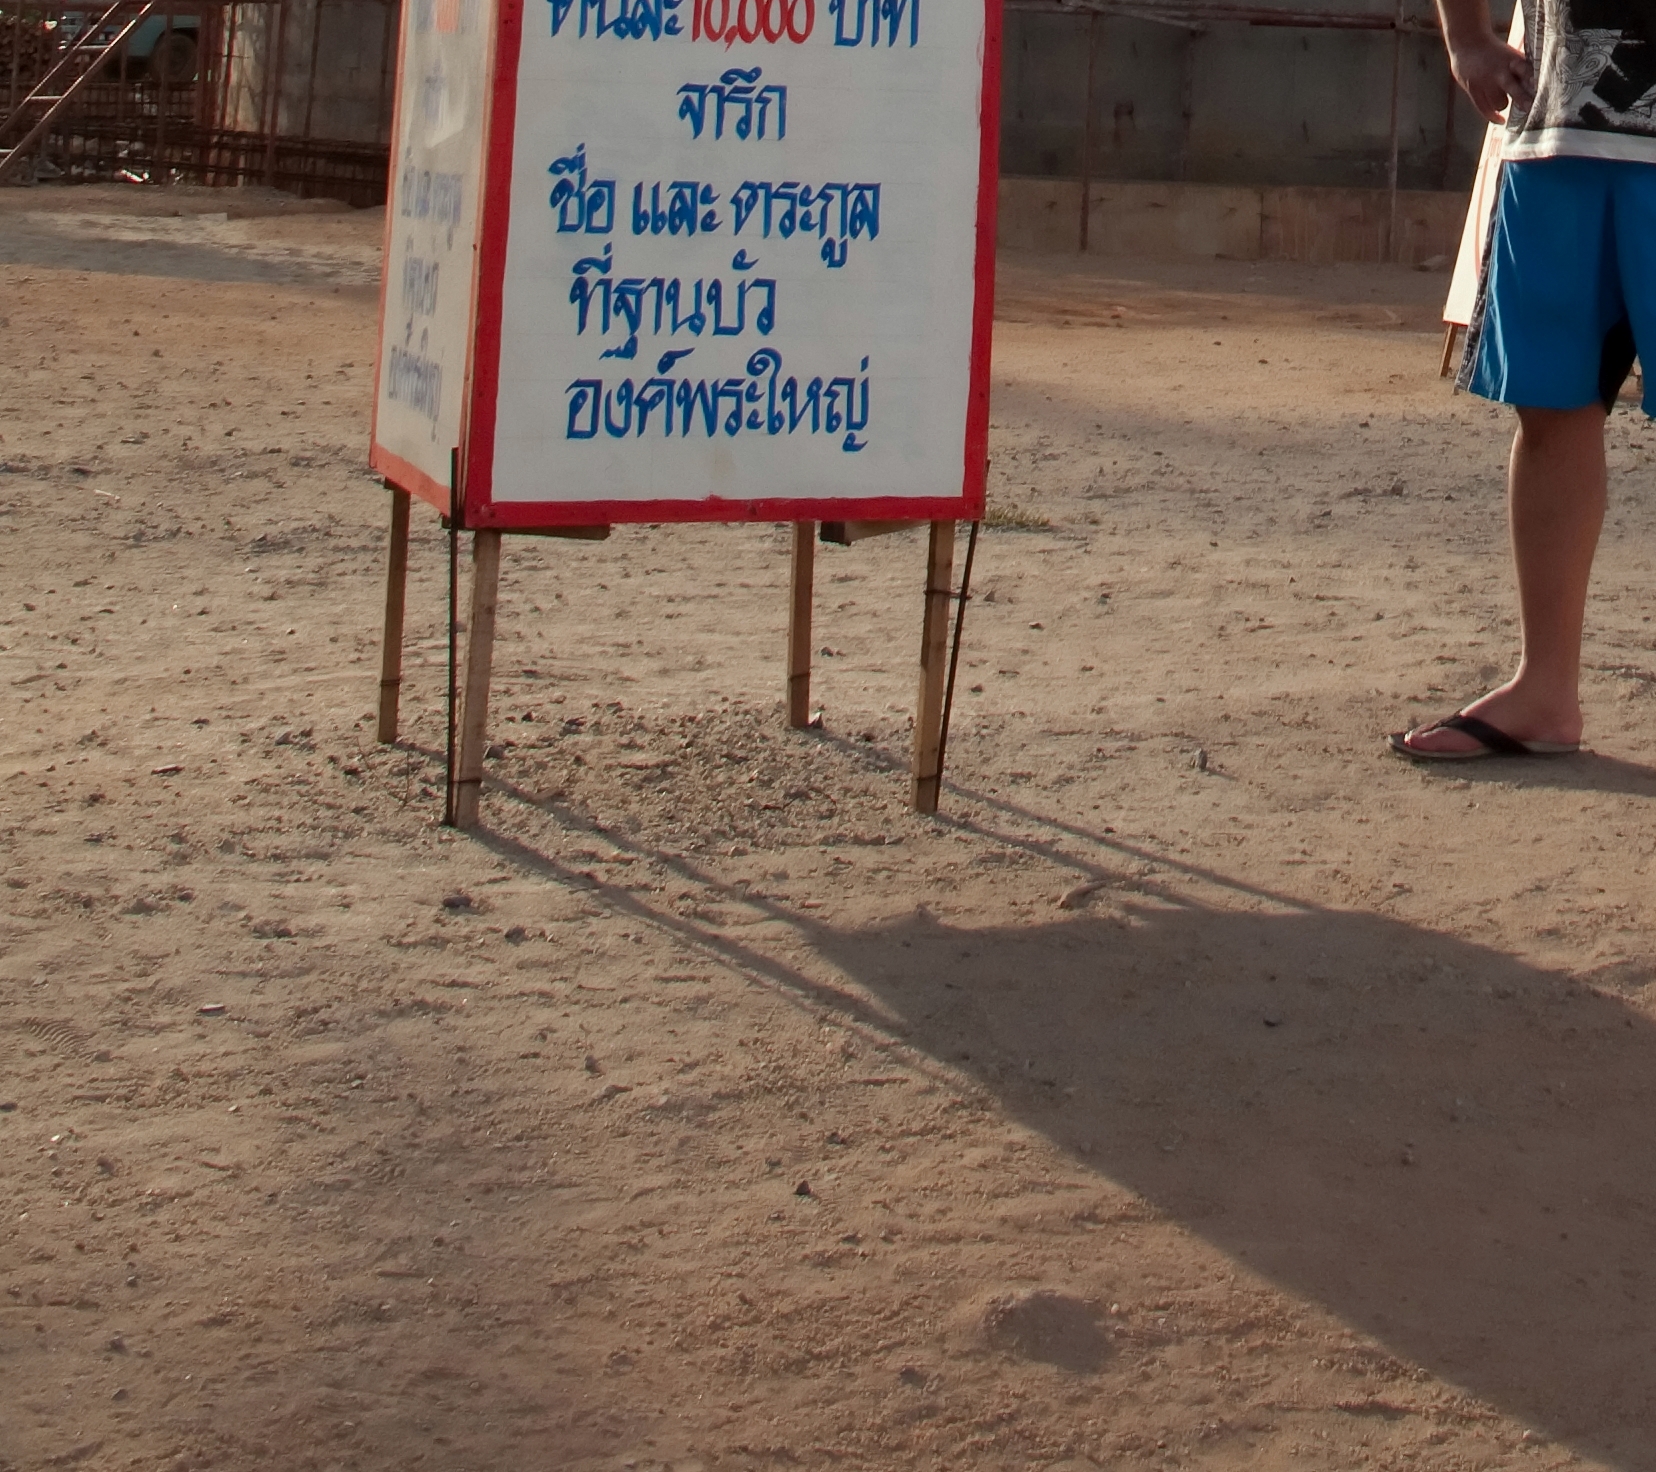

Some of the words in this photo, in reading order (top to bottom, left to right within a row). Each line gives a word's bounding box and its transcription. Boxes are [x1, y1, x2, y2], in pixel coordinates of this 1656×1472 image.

[675, 66, 788, 141] จารึก
[547, 142, 617, 235] ชื่อ
[630, 181, 723, 237] และ
[729, 179, 882, 269] ตระกูล
[568, 242, 777, 361] ที่ฐานบัว
[564, 346, 870, 454] องค์พระใหญ่
